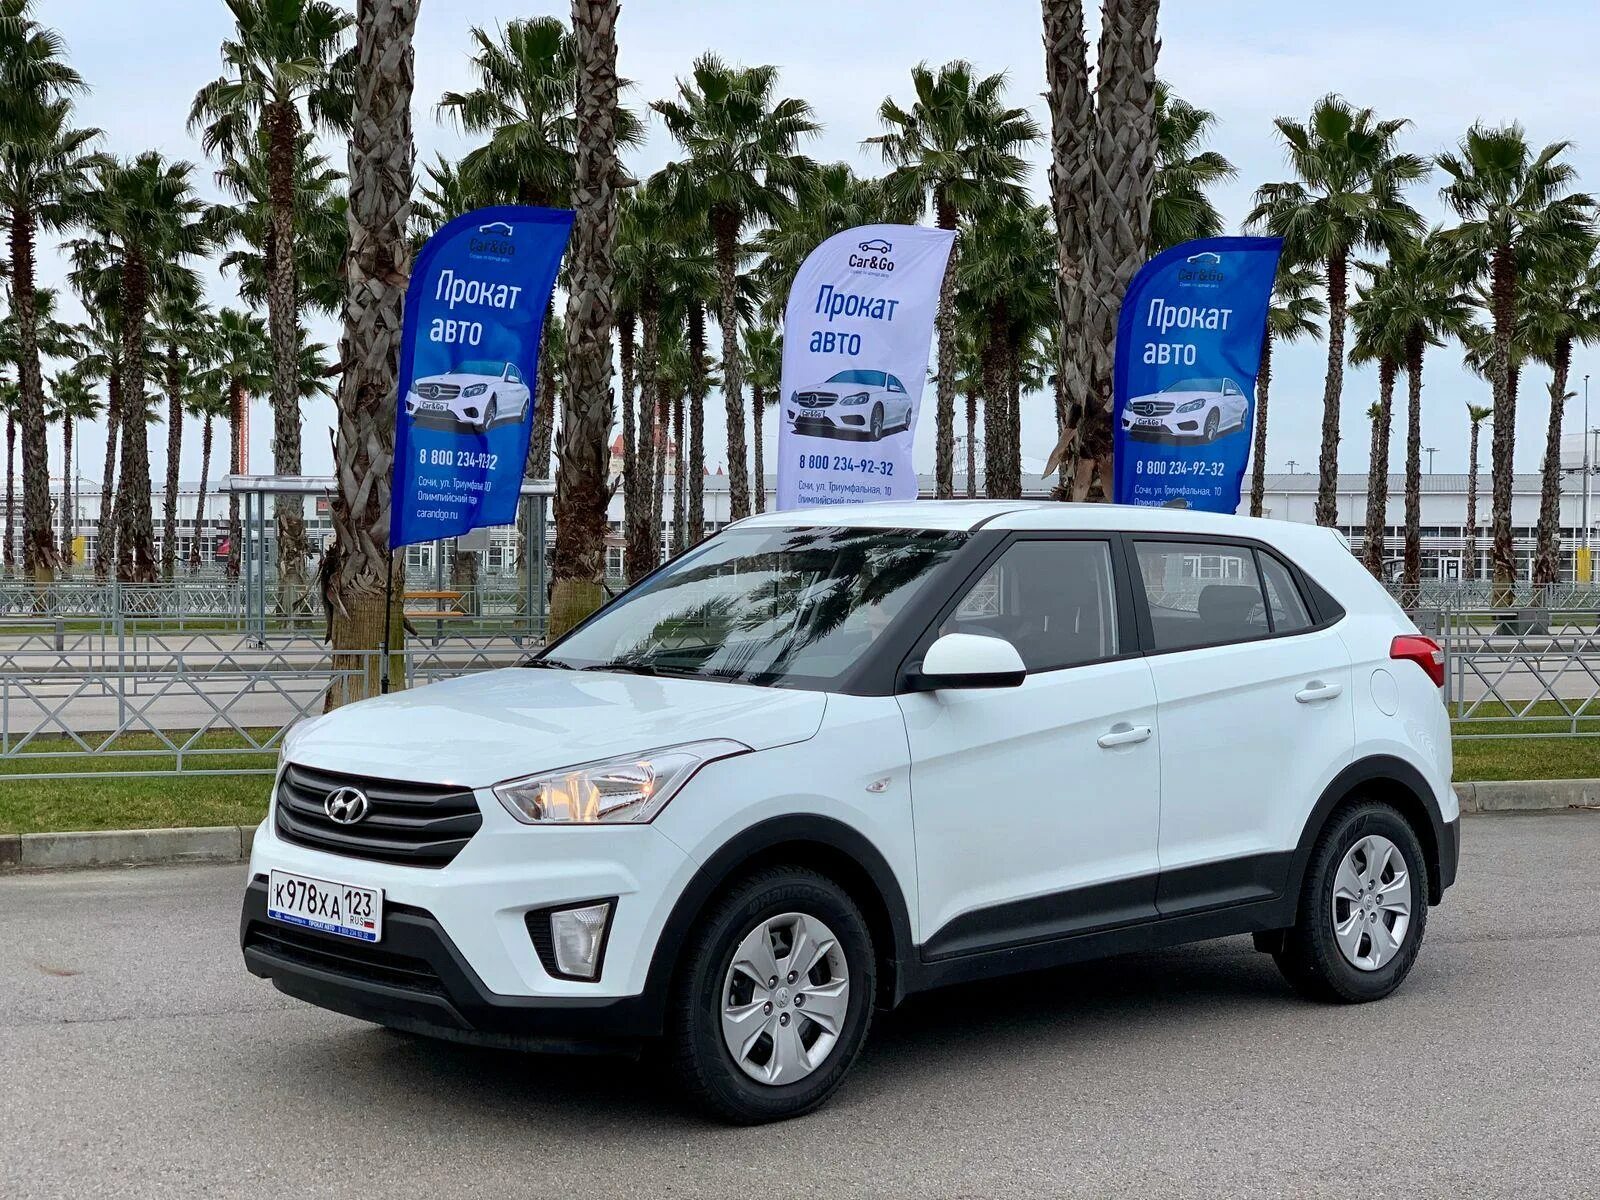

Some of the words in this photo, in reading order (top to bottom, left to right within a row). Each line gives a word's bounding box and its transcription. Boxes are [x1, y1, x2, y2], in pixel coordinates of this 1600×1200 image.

[469, 238, 515, 257] Car&Go
[848, 254, 895, 272] Car&Go
[435, 269, 522, 310] Прокат
[815, 284, 900, 322] Прокат
[1147, 298, 1233, 335] Прокат
[429, 318, 483, 346] авто
[809, 330, 861, 356] авто
[1143, 342, 1197, 366] авто
[421, 401, 444, 411] Car&Go
[1138, 418, 1159, 427] Car&Go
[419, 448, 427, 464] 8
[431, 449, 453, 466] 800
[799, 454, 806, 469] 8
[808, 455, 829, 470] 800
[833, 456, 894, 476] 234-92-32
[1136, 460, 1143, 474] 8
[1147, 460, 1166, 475] 800
[1168, 461, 1225, 477] 234-92-32
[418, 475, 438, 488] Сочи,
[798, 480, 814, 491] Сочи,
[829, 481, 882, 496] Триумфальная,
[884, 486, 892, 497] 10
[1134, 484, 1152, 495] Сочи,
[1214, 486, 1222, 497] 10
[416, 508, 459, 521] carandgo.ru
[275, 879, 341, 921] К978ХА
[344, 890, 372, 917] 123
[349, 915, 364, 926] RUS
